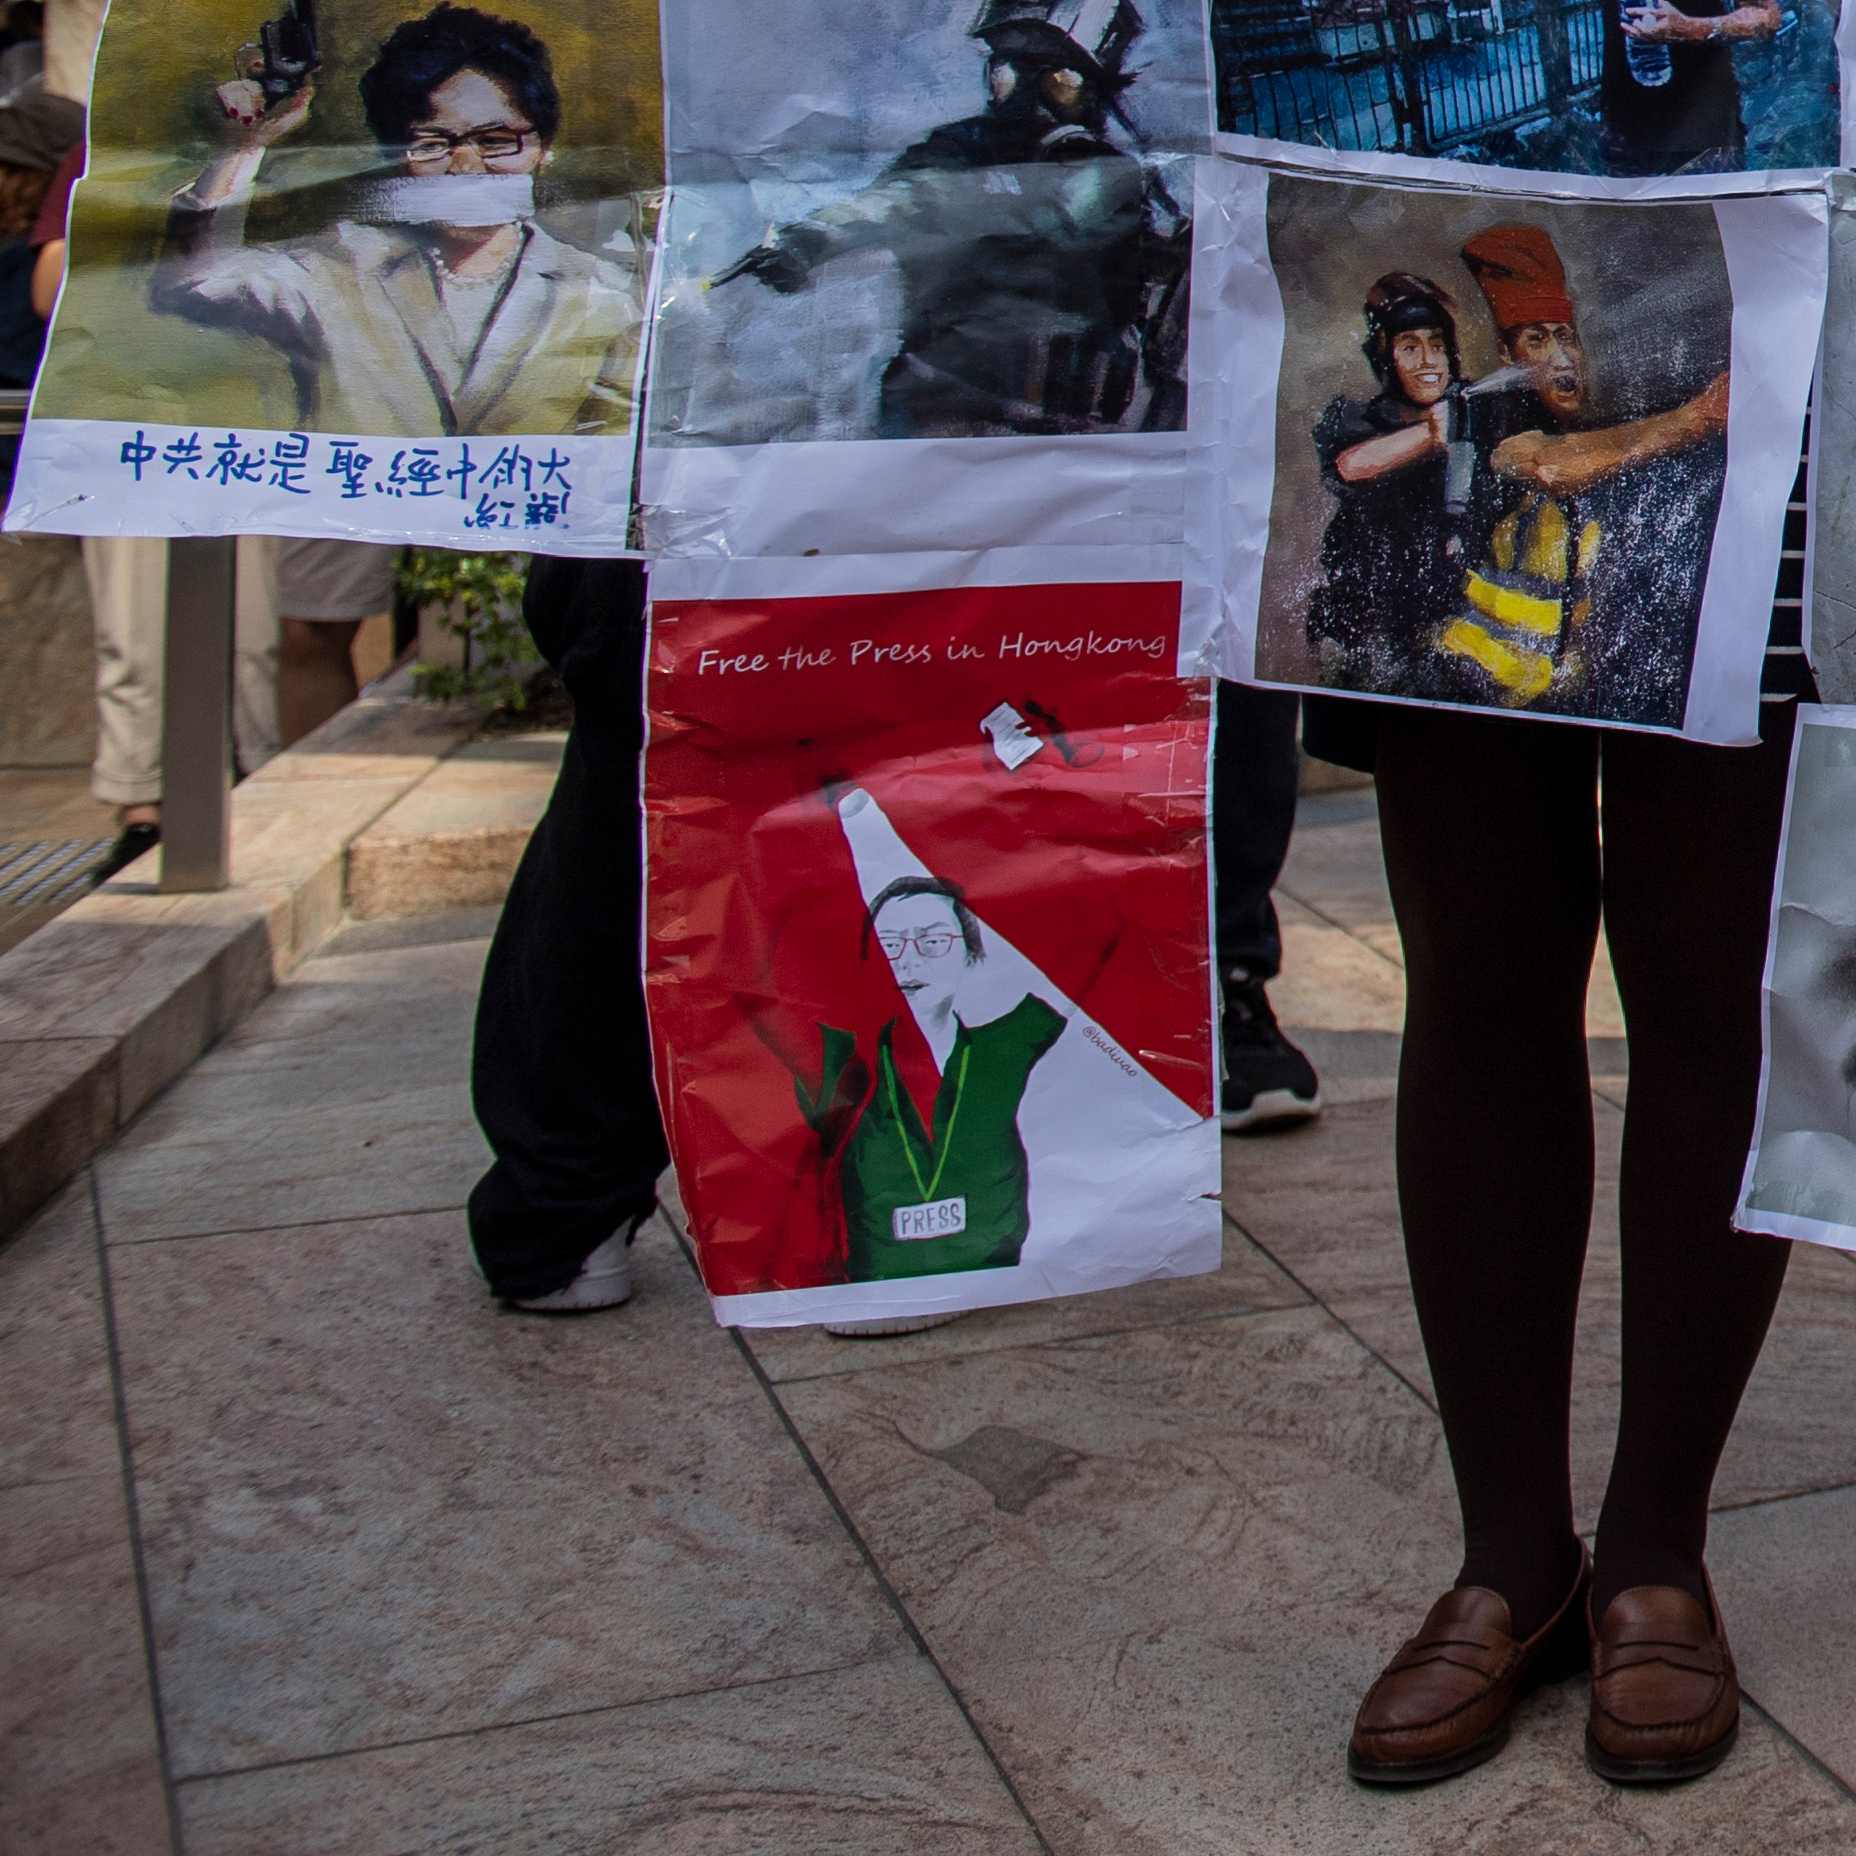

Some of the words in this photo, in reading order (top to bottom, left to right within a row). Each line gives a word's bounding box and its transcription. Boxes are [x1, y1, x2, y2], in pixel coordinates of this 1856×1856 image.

[697, 648, 769, 676] Free
[777, 644, 837, 672] the
[849, 638, 932, 667] Press
[946, 634, 985, 661] in
[998, 629, 1167, 662] Hongkong
[901, 1202, 961, 1235] PRESS
